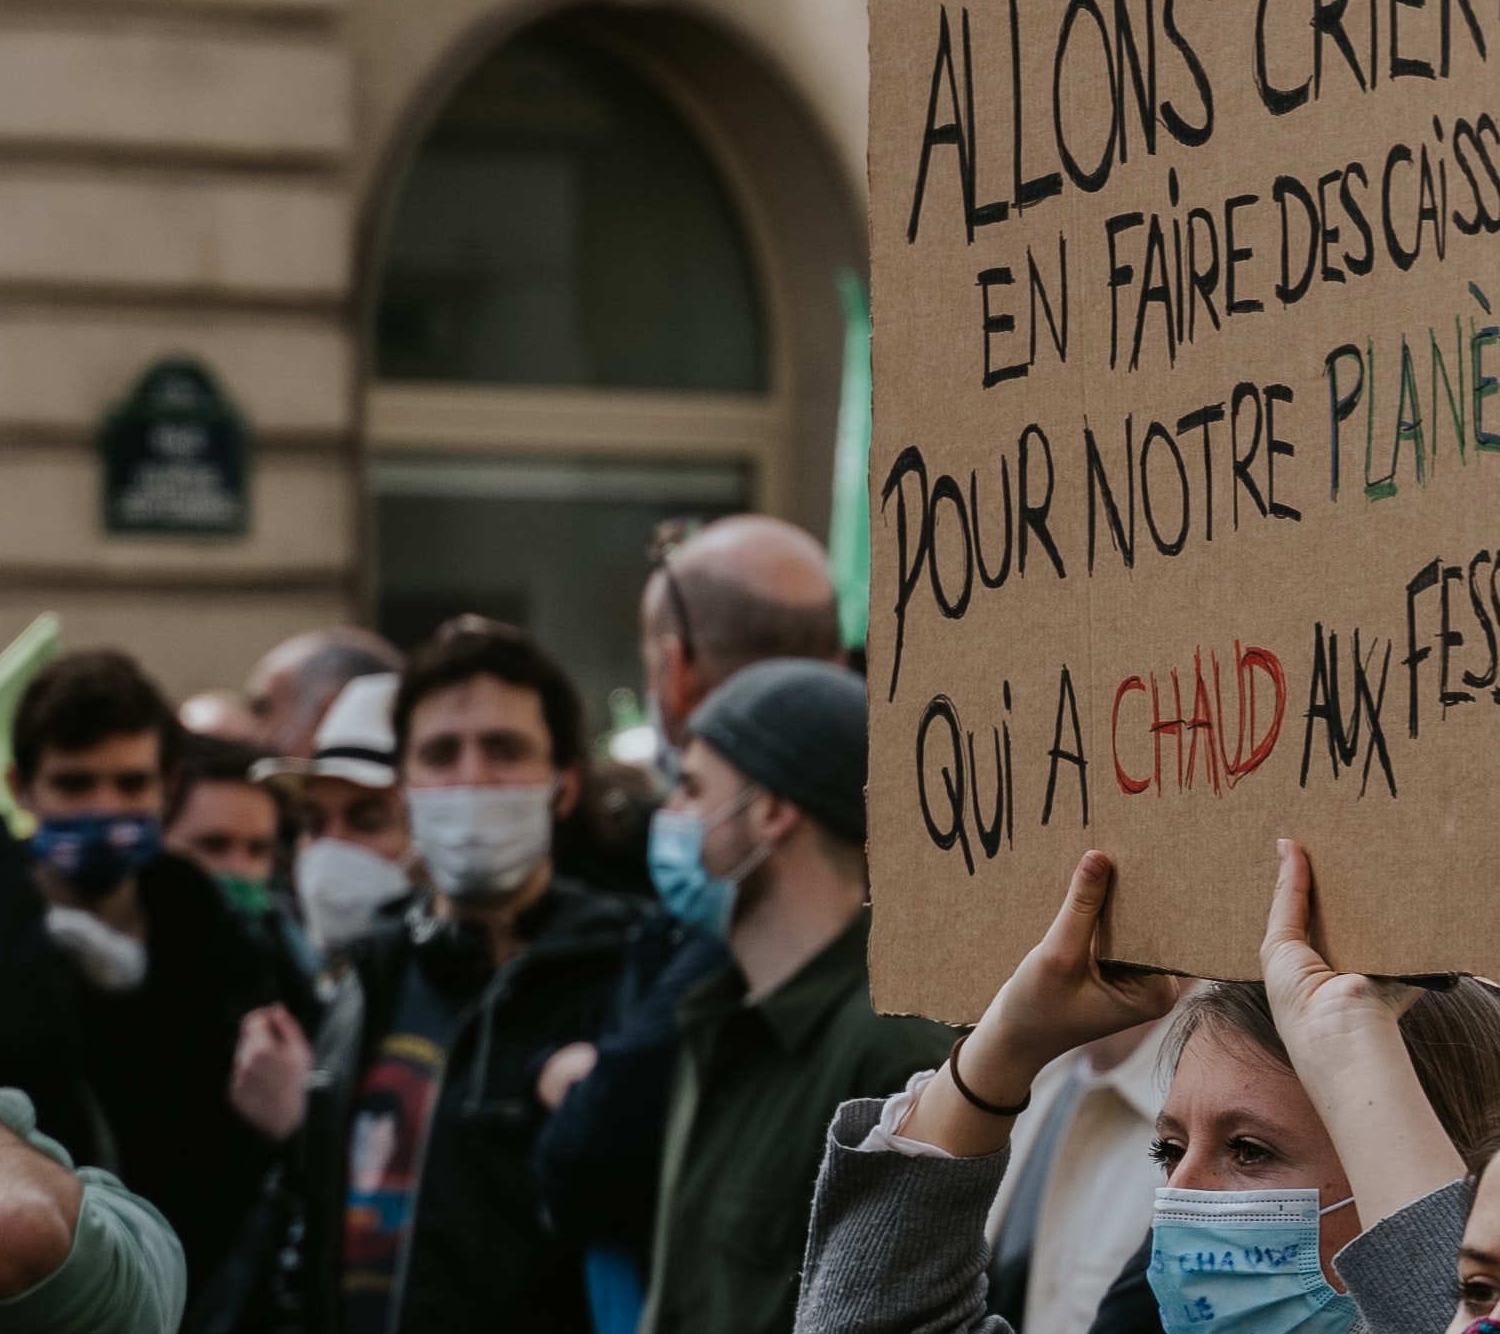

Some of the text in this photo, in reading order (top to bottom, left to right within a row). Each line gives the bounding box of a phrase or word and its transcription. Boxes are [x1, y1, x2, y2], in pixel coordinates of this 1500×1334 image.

[975, 229, 1068, 390] EN
[1272, 161, 1375, 308] DES
[881, 423, 1066, 703] POUR
[1083, 383, 1300, 577] NOTRE
[1041, 664, 1088, 828] A
[1111, 639, 1287, 798] CHAUD
[1300, 621, 1398, 800] AUX
